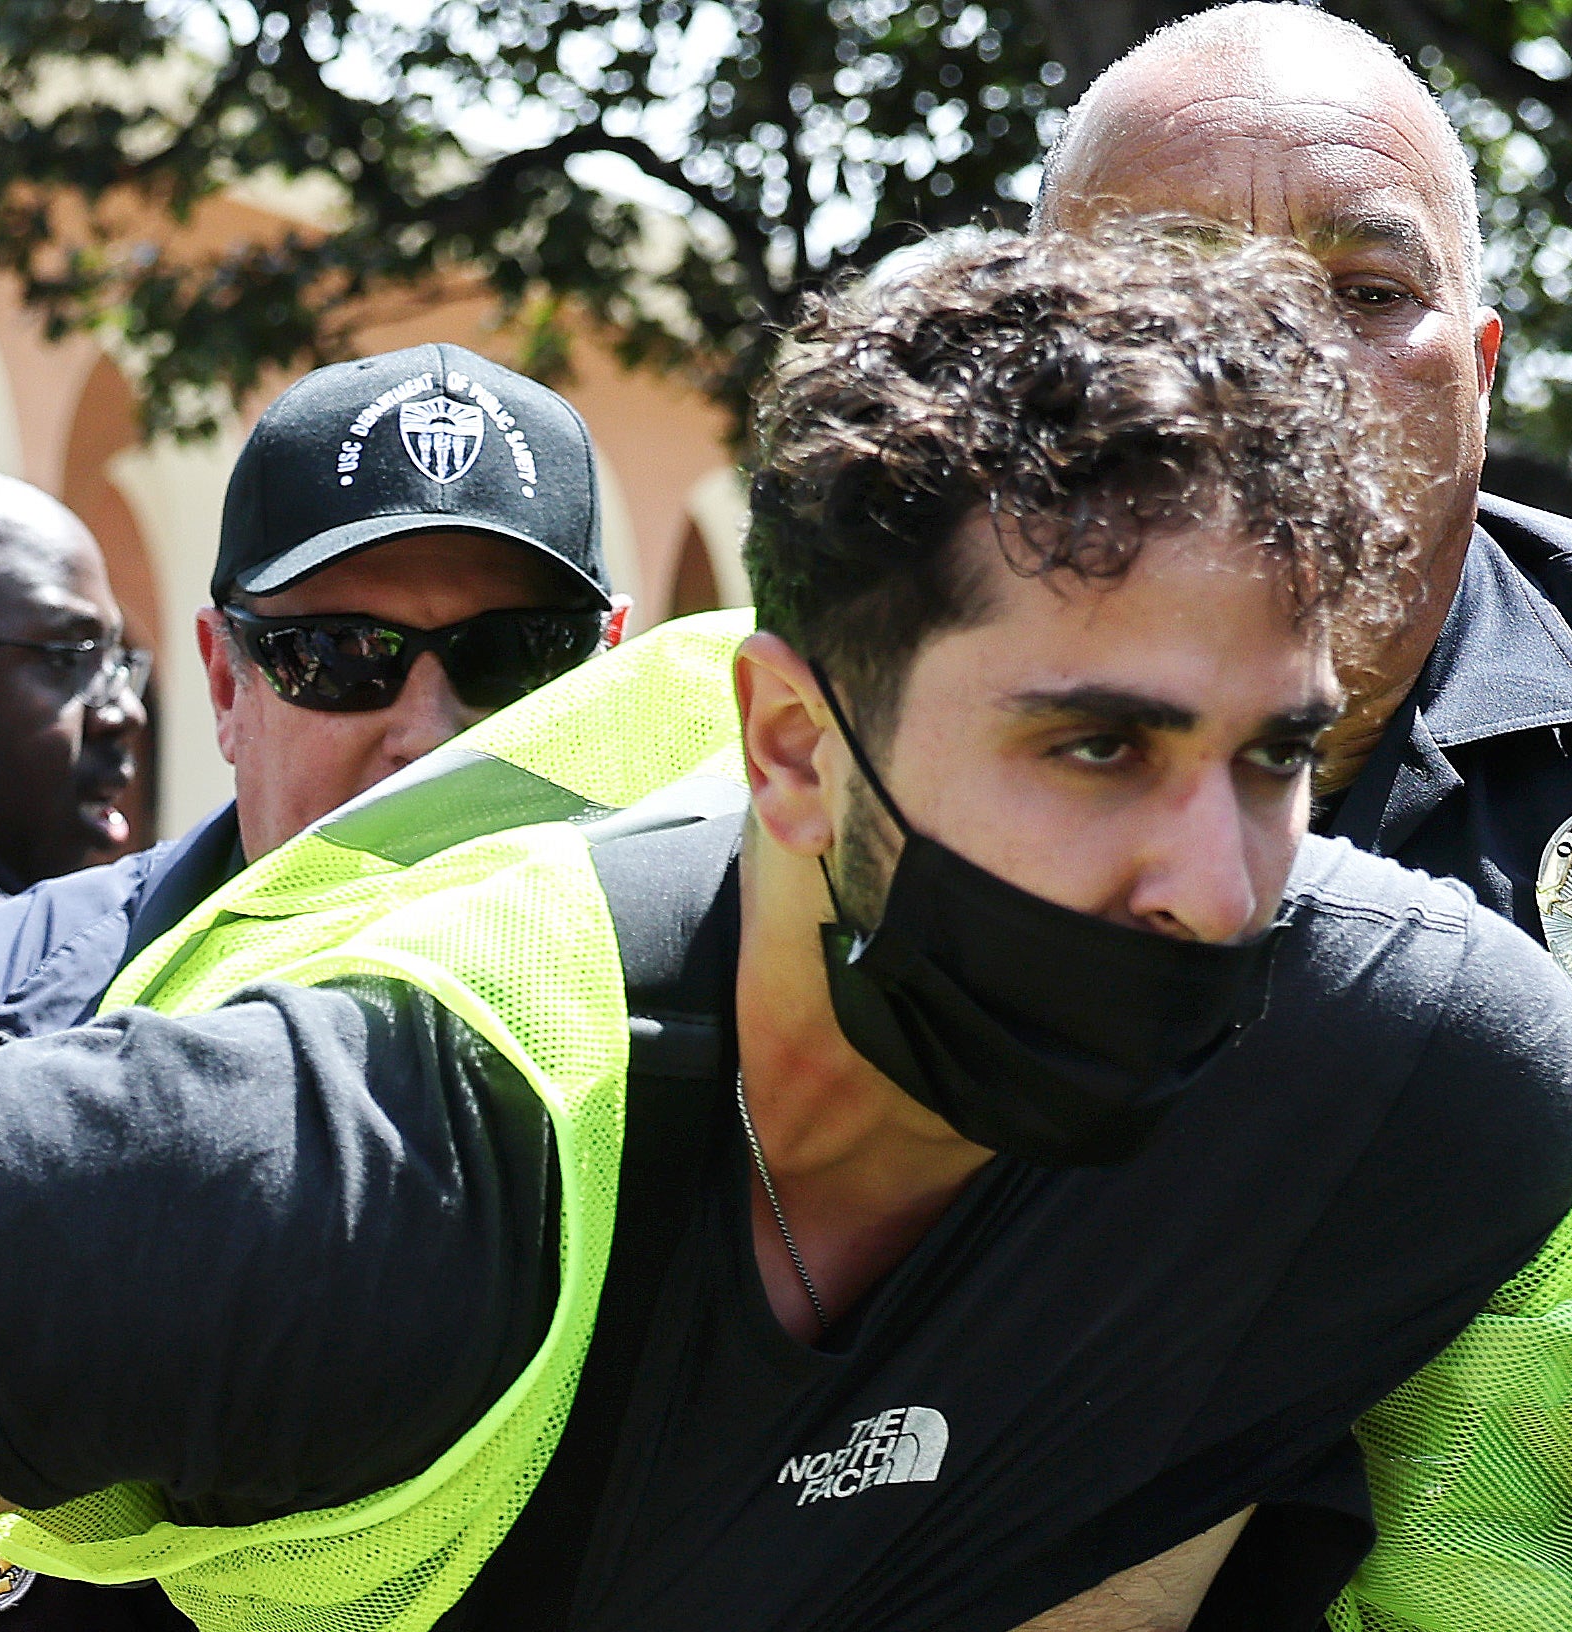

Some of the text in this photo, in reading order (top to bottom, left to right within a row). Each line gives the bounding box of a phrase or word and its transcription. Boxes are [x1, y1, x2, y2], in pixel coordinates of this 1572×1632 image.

[336, 371, 538, 485] USC DEPARTMENT OF PUBLIC SAFETY
[847, 1407, 907, 1447] THE
[777, 1436, 898, 1484] NORTH
[795, 1467, 880, 1507] FACE
